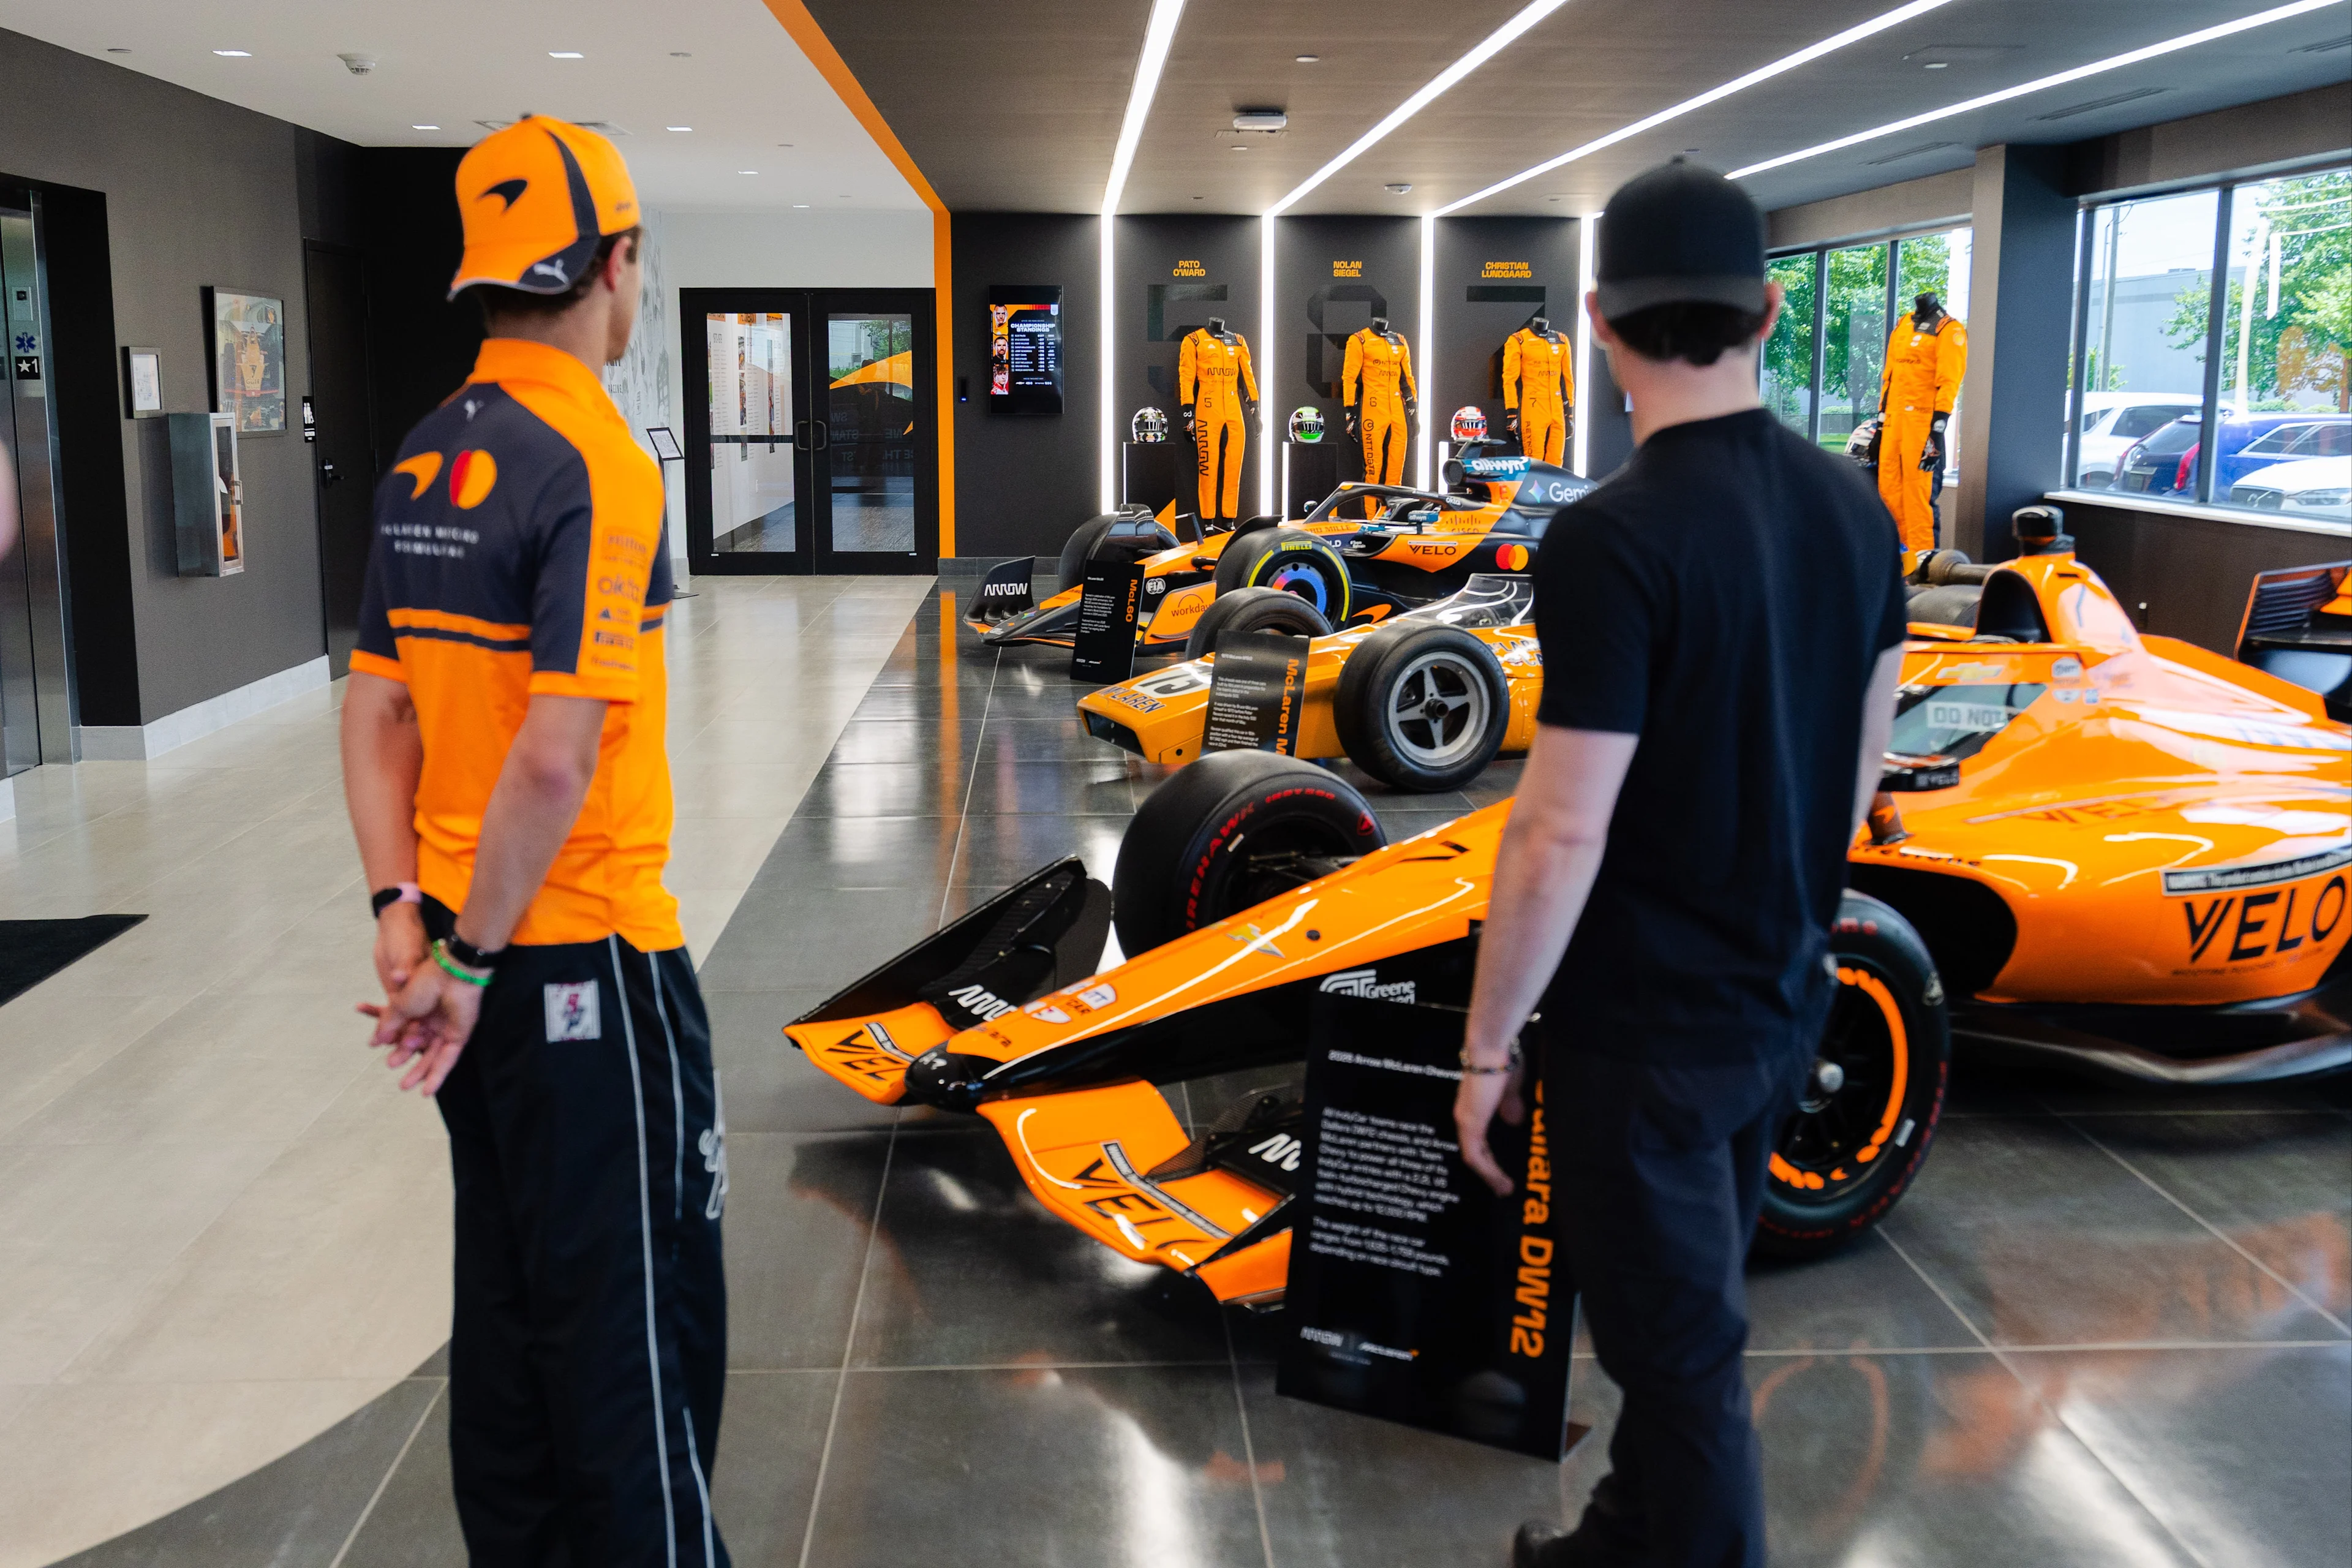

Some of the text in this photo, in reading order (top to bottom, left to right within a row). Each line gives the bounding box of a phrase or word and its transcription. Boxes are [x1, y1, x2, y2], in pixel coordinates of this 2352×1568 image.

[1204, 398, 1212, 408] 5
[1529, 398, 1537, 407] 7
[1471, 459, 1525, 475] allwyn
[1446, 497, 1462, 506] okta
[1281, 541, 1312, 551] PIRELLI
[1409, 545, 1457, 555] VELO
[984, 582, 1028, 596] ARROW
[1147, 579, 1165, 594] FIA
[1278, 658, 1299, 734] McLaren
[1934, 706, 1962, 724] DO
[2184, 875, 2346, 965] VELO
[1366, 980, 1416, 1000] Greene
[824, 1030, 908, 1081] VEL
[1510, 1235, 1554, 1358] DW12
